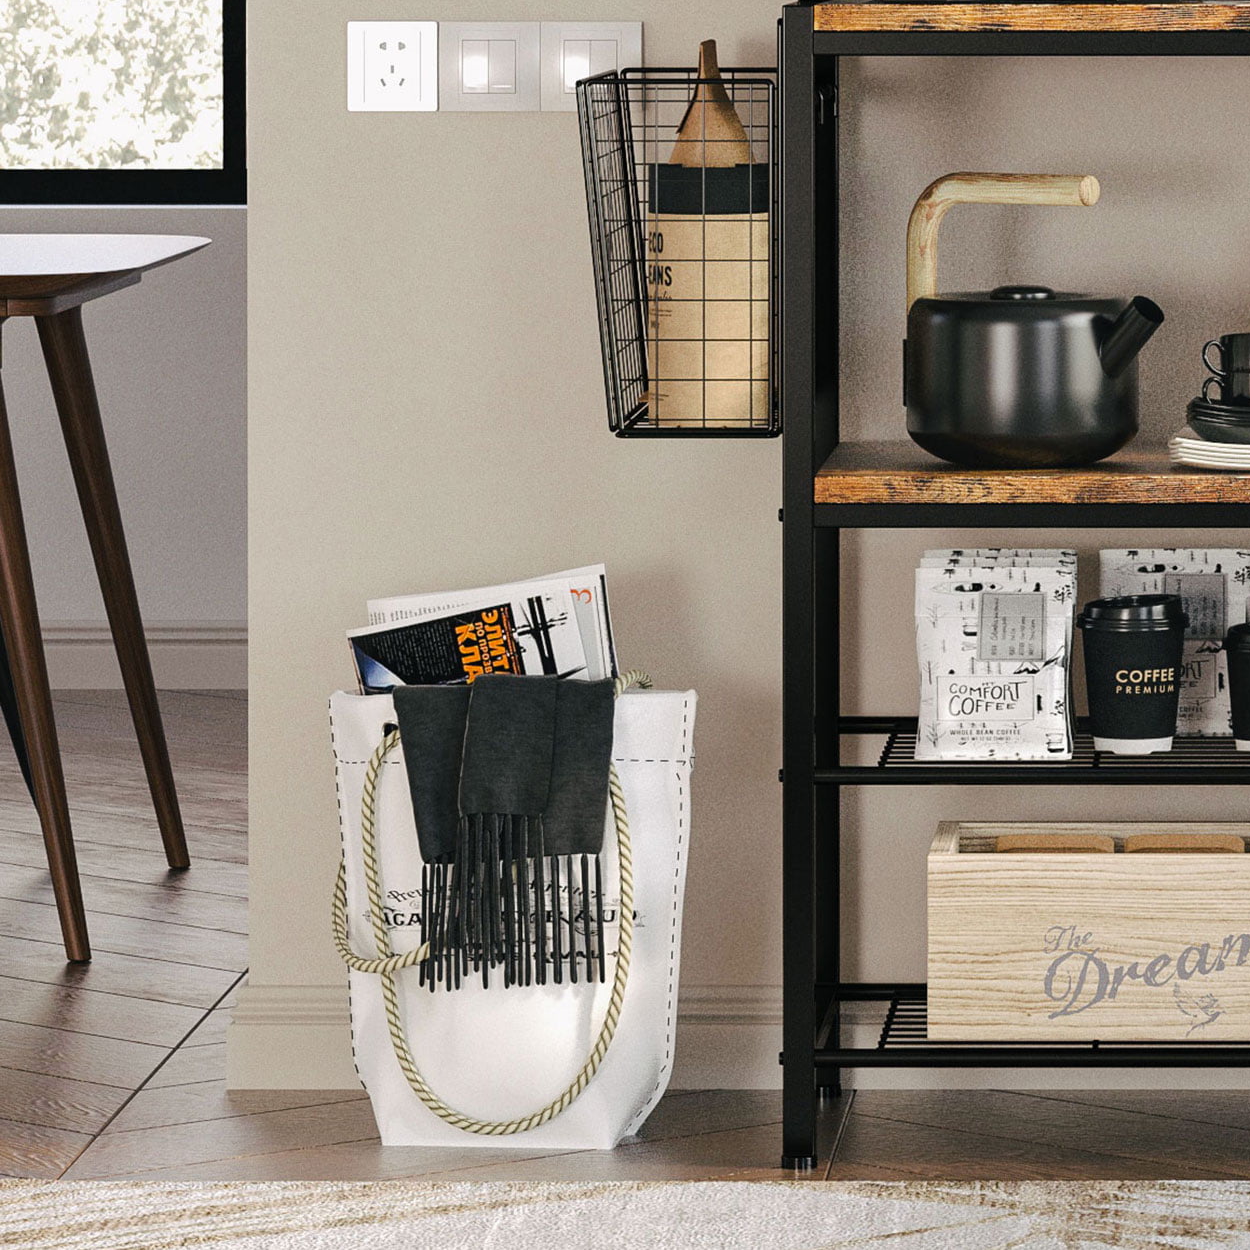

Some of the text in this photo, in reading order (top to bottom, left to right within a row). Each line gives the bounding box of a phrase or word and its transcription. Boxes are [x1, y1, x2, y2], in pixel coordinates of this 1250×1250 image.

[648, 265, 672, 286] EANS
[482, 610, 511, 674] ЭЛИТ
[1116, 668, 1174, 683] COFFEE
[950, 680, 1028, 702] COMFORT
[1116, 684, 1174, 694] PREMIUM
[948, 694, 1016, 716] COFFEE
[1043, 924, 1094, 952] The
